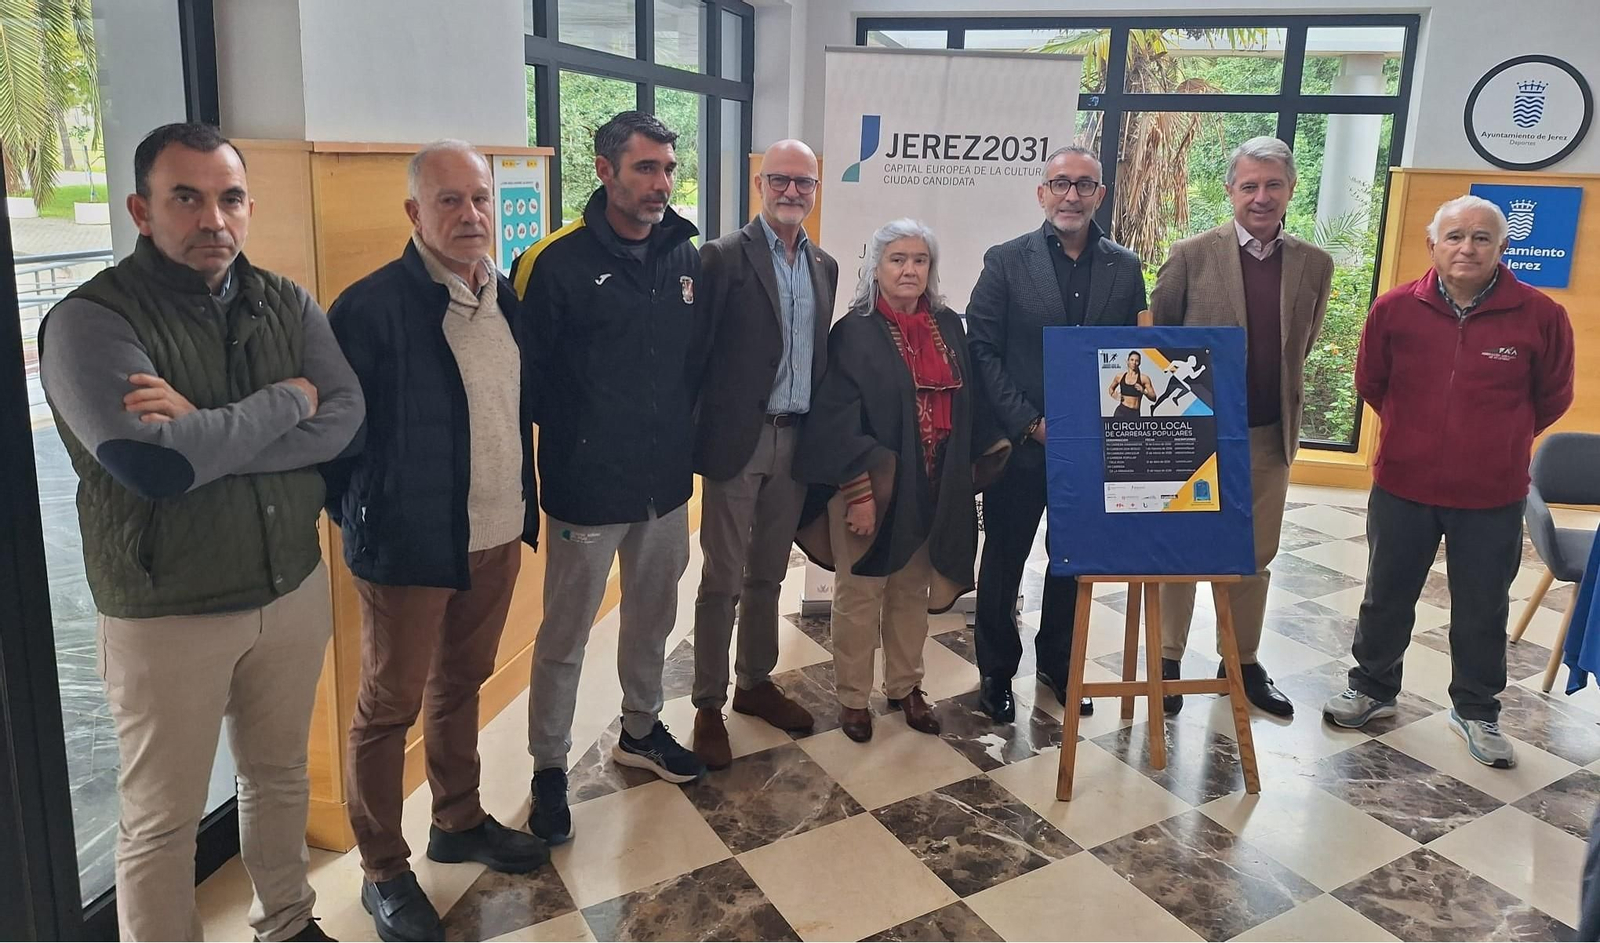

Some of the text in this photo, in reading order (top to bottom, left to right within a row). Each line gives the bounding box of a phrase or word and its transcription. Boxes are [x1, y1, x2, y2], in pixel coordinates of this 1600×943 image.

[1481, 131, 1568, 141] Ayuntamiento de Jerez
[885, 133, 1048, 162] JEREZ2031
[884, 163, 923, 174] CAPITAL
[926, 164, 971, 175] EUROPEA
[974, 165, 986, 175] DE
[989, 166, 1002, 176] LA
[883, 175, 975, 186] CIUDAD CANDIDATA
[1503, 245, 1566, 258] tamiento
[1104, 421, 1193, 430] II CIRCUITO LOCAL
